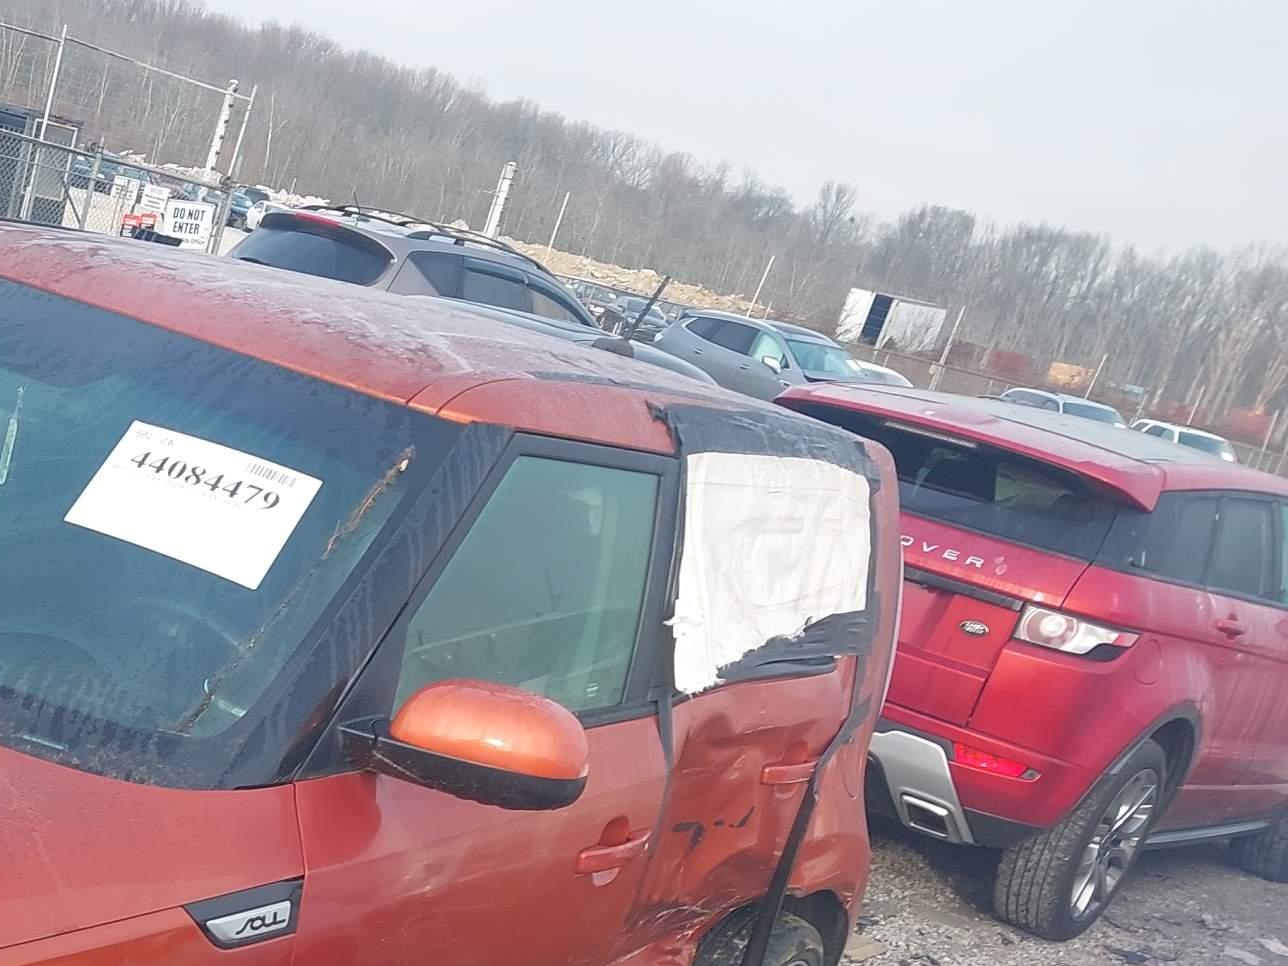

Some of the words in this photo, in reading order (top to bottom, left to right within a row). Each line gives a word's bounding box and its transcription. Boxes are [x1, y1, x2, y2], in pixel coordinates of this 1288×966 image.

[173, 207, 186, 219] DO
[187, 209, 206, 222] NOT
[173, 221, 200, 235] ENTER
[130, 451, 281, 510] 44084479
[900, 534, 985, 568] OVER
